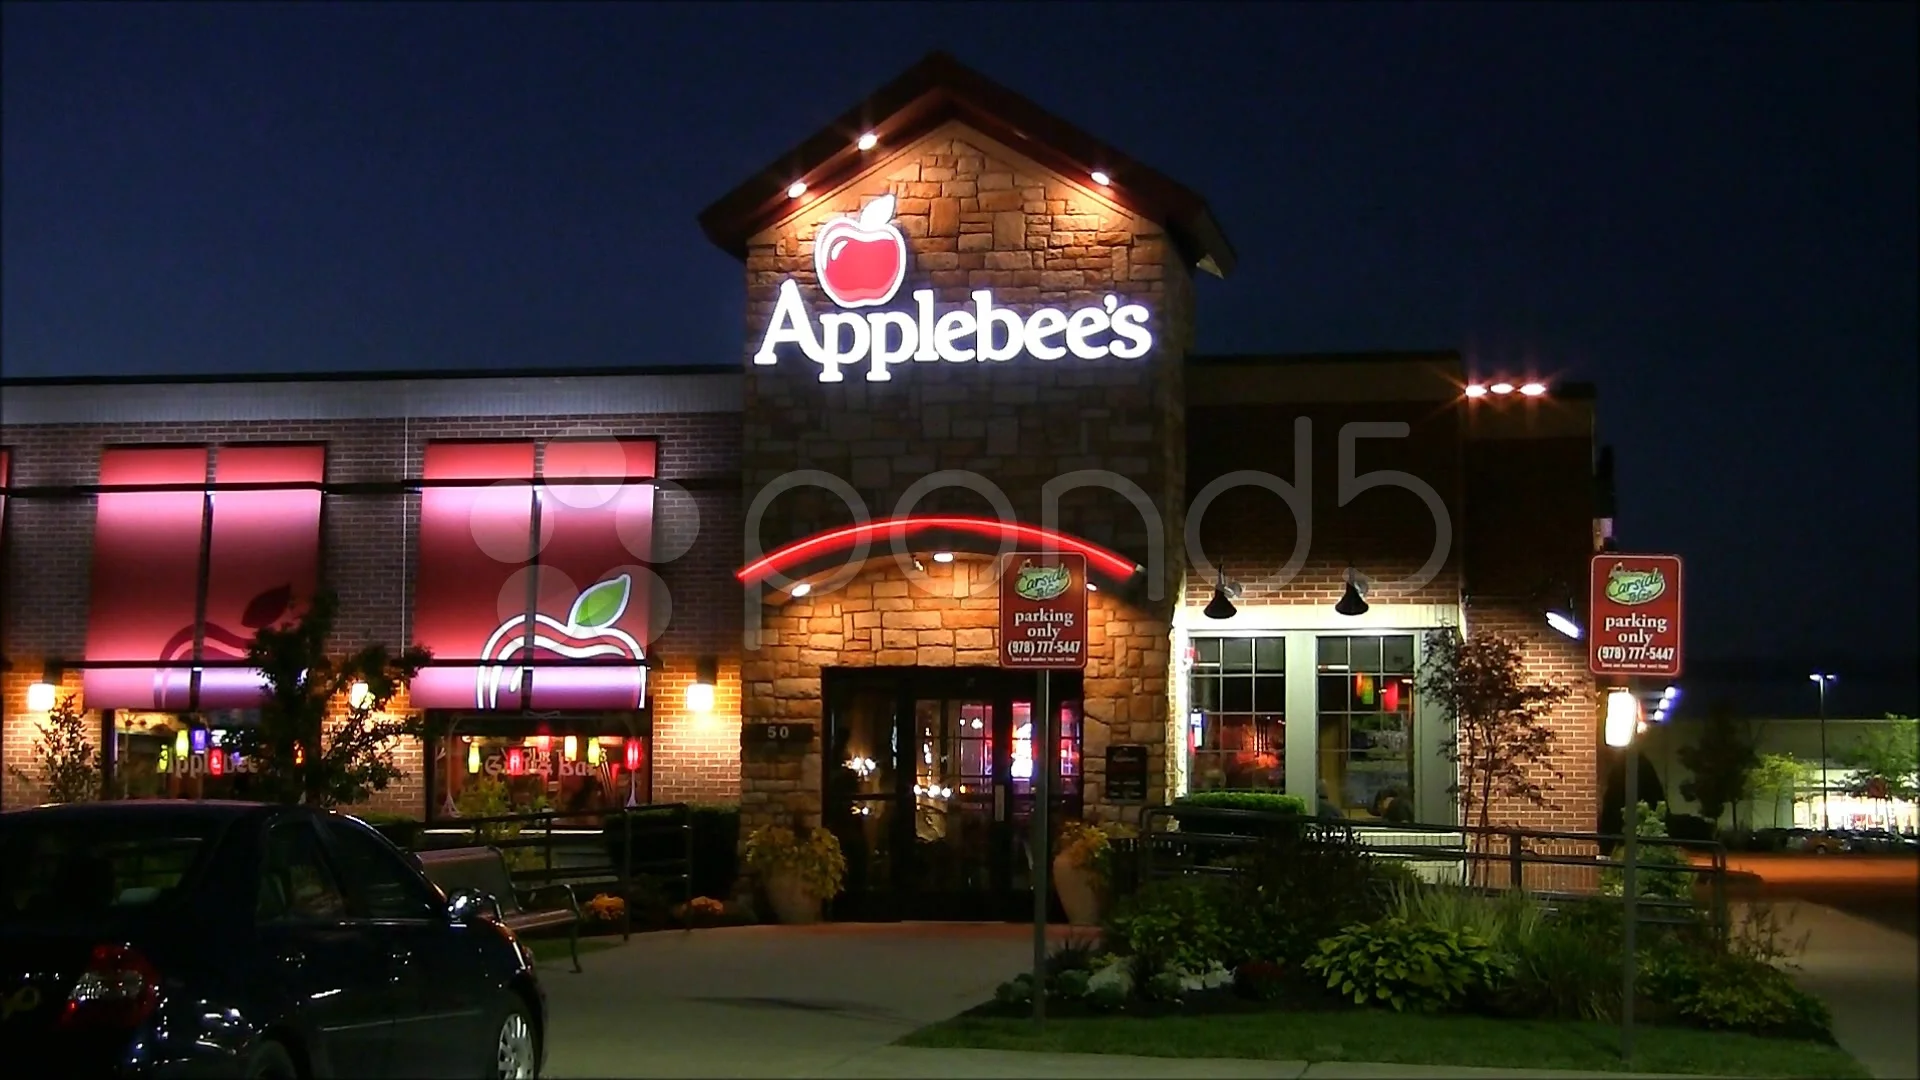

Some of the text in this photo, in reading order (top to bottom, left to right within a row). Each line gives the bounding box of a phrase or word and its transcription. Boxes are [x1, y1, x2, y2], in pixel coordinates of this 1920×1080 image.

[753, 278, 1153, 383] Applebee's
[1014, 607, 1074, 627] parking
[1605, 612, 1668, 633] parking
[1027, 622, 1061, 641] only
[1618, 628, 1653, 648] only
[1007, 640, 1081, 656] (978) 777-5447
[1597, 646, 1675, 662] (978) 777-5447
[767, 725, 789, 739] 50
